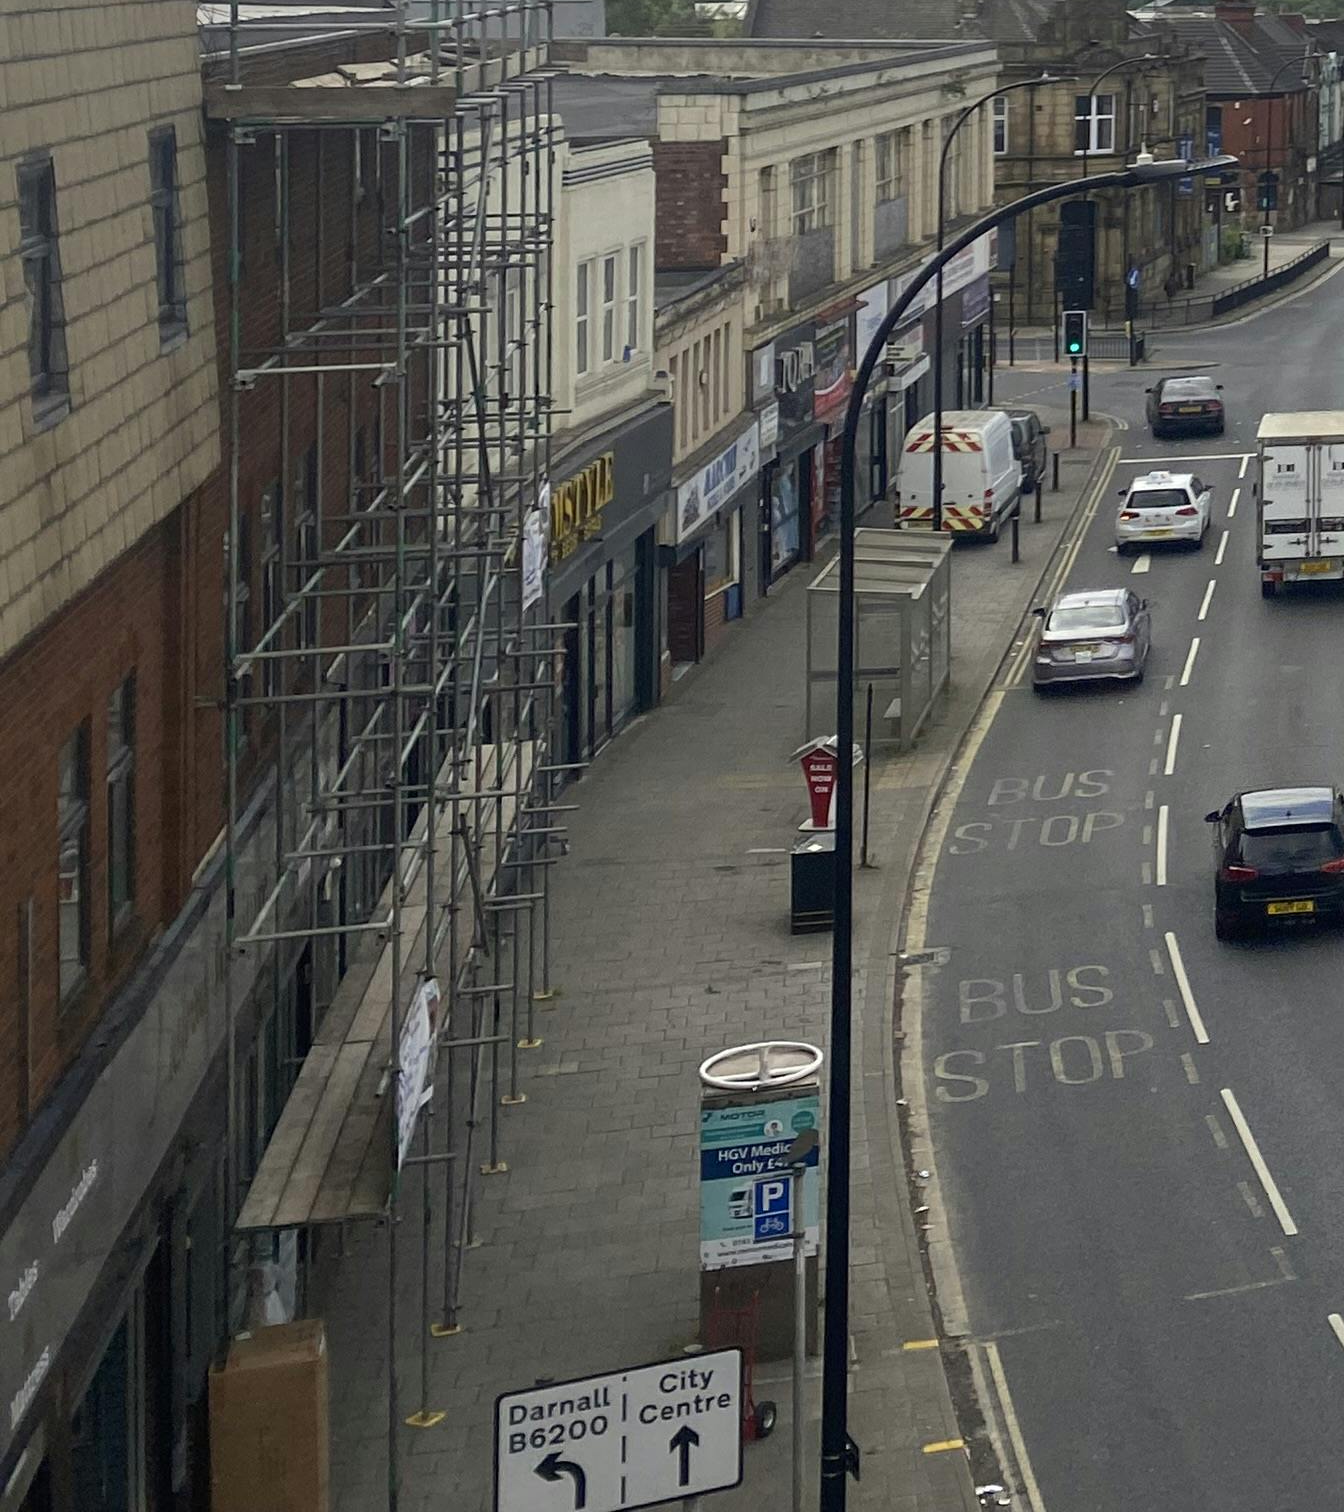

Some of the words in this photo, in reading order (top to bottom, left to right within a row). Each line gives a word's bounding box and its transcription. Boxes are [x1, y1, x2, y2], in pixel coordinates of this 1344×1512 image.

[810, 764, 832, 772] SALE
[988, 769, 1116, 806] BUS
[949, 812, 1126, 855] STOP
[959, 964, 1114, 1024] BUS
[935, 1029, 1154, 1103] STOP
[720, 1110, 766, 1121] MOTOR
[718, 1148, 748, 1162] HGV
[751, 1143, 792, 1157] Medic
[732, 1161, 763, 1174] Only
[762, 1182, 784, 1211] P
[659, 1369, 714, 1393] City
[509, 1387, 611, 1426] Darnall
[639, 1392, 731, 1425] Centre
[509, 1415, 608, 1454] B6200
